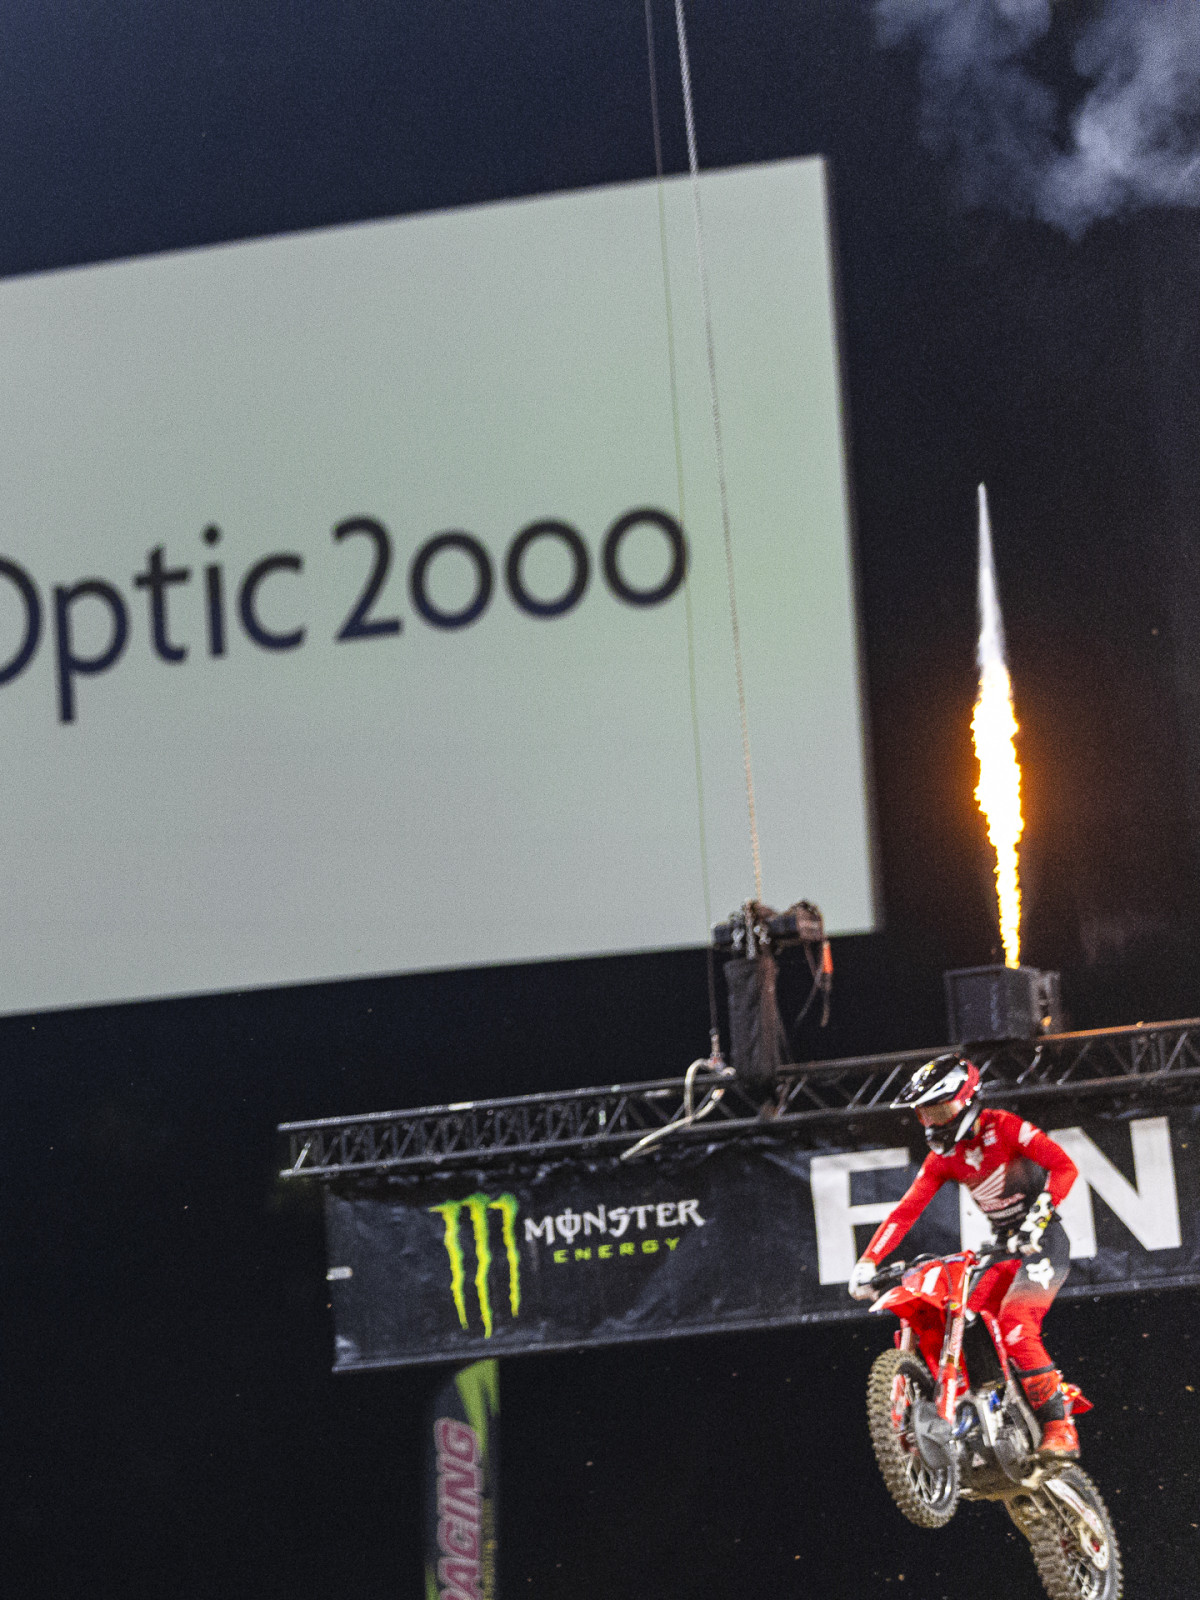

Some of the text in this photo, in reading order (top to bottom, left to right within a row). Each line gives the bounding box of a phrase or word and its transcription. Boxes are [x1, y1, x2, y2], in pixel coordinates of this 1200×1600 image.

[331, 505, 691, 646] 2000
[524, 1199, 706, 1245] MONSTER
[553, 1237, 681, 1264] ENERGY
